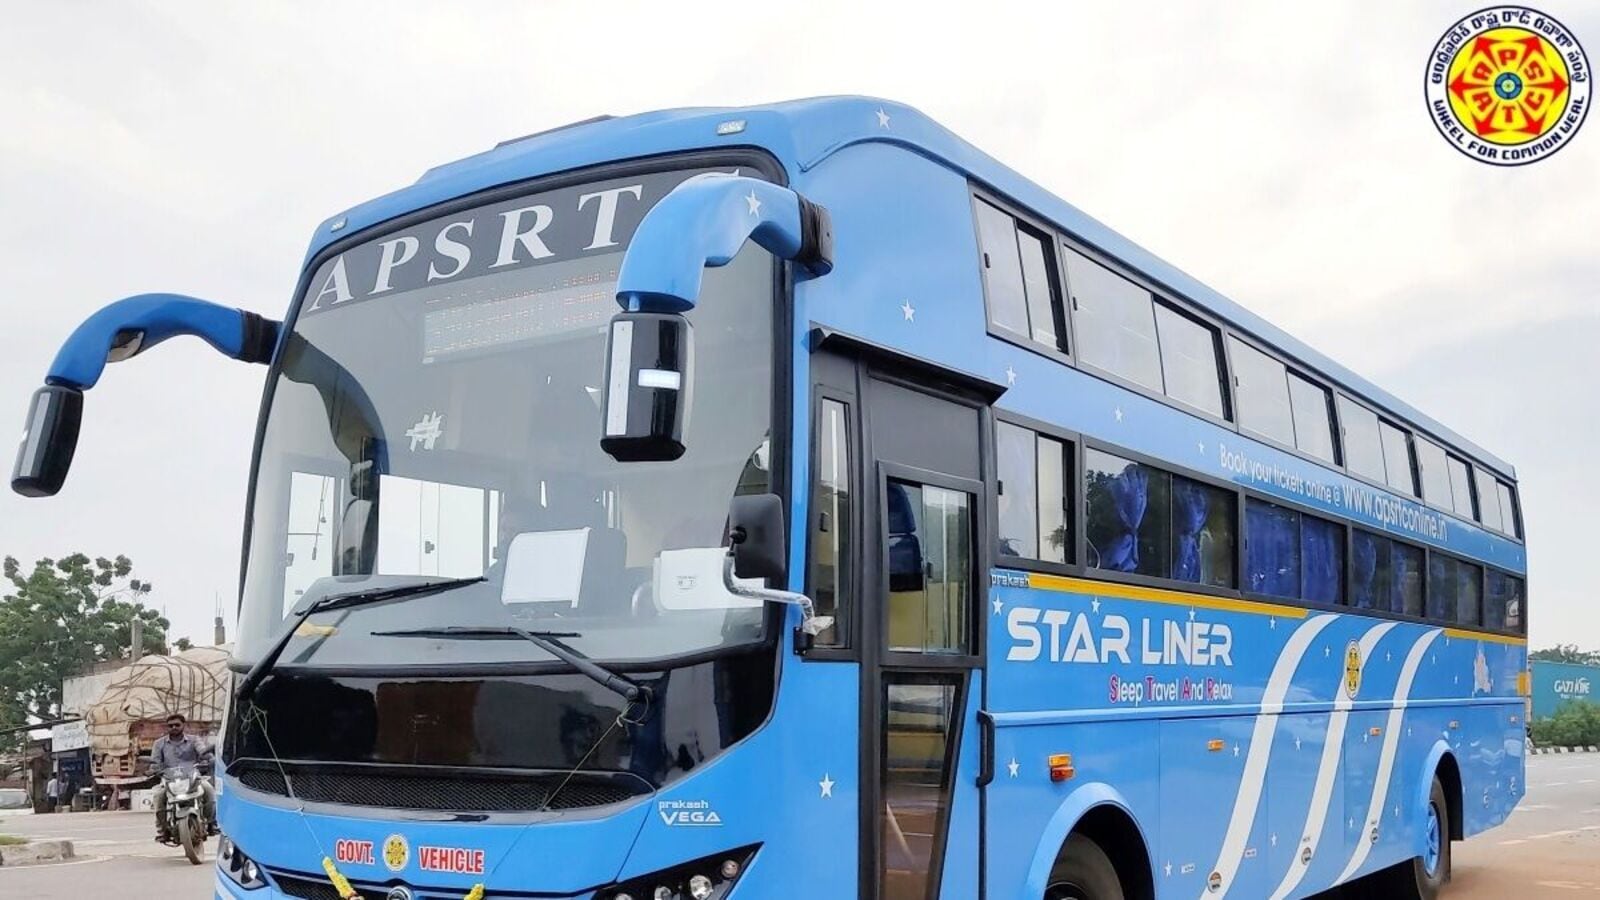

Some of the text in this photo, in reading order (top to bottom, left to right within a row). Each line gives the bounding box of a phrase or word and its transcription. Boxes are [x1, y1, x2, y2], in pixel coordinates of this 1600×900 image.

[307, 168, 740, 313] APSRT
[1219, 443, 1248, 477] Book
[1250, 459, 1274, 484] your
[1274, 464, 1304, 495] tickets
[1306, 480, 1332, 503] online
[990, 572, 1030, 588] prakash
[1007, 607, 1233, 666] STAR LINER
[1110, 674, 1233, 706] Sleep Travel And Relax
[659, 800, 709, 812] prakash
[660, 811, 721, 826] VEGA
[336, 839, 484, 874] GOVT. VEHICLE
